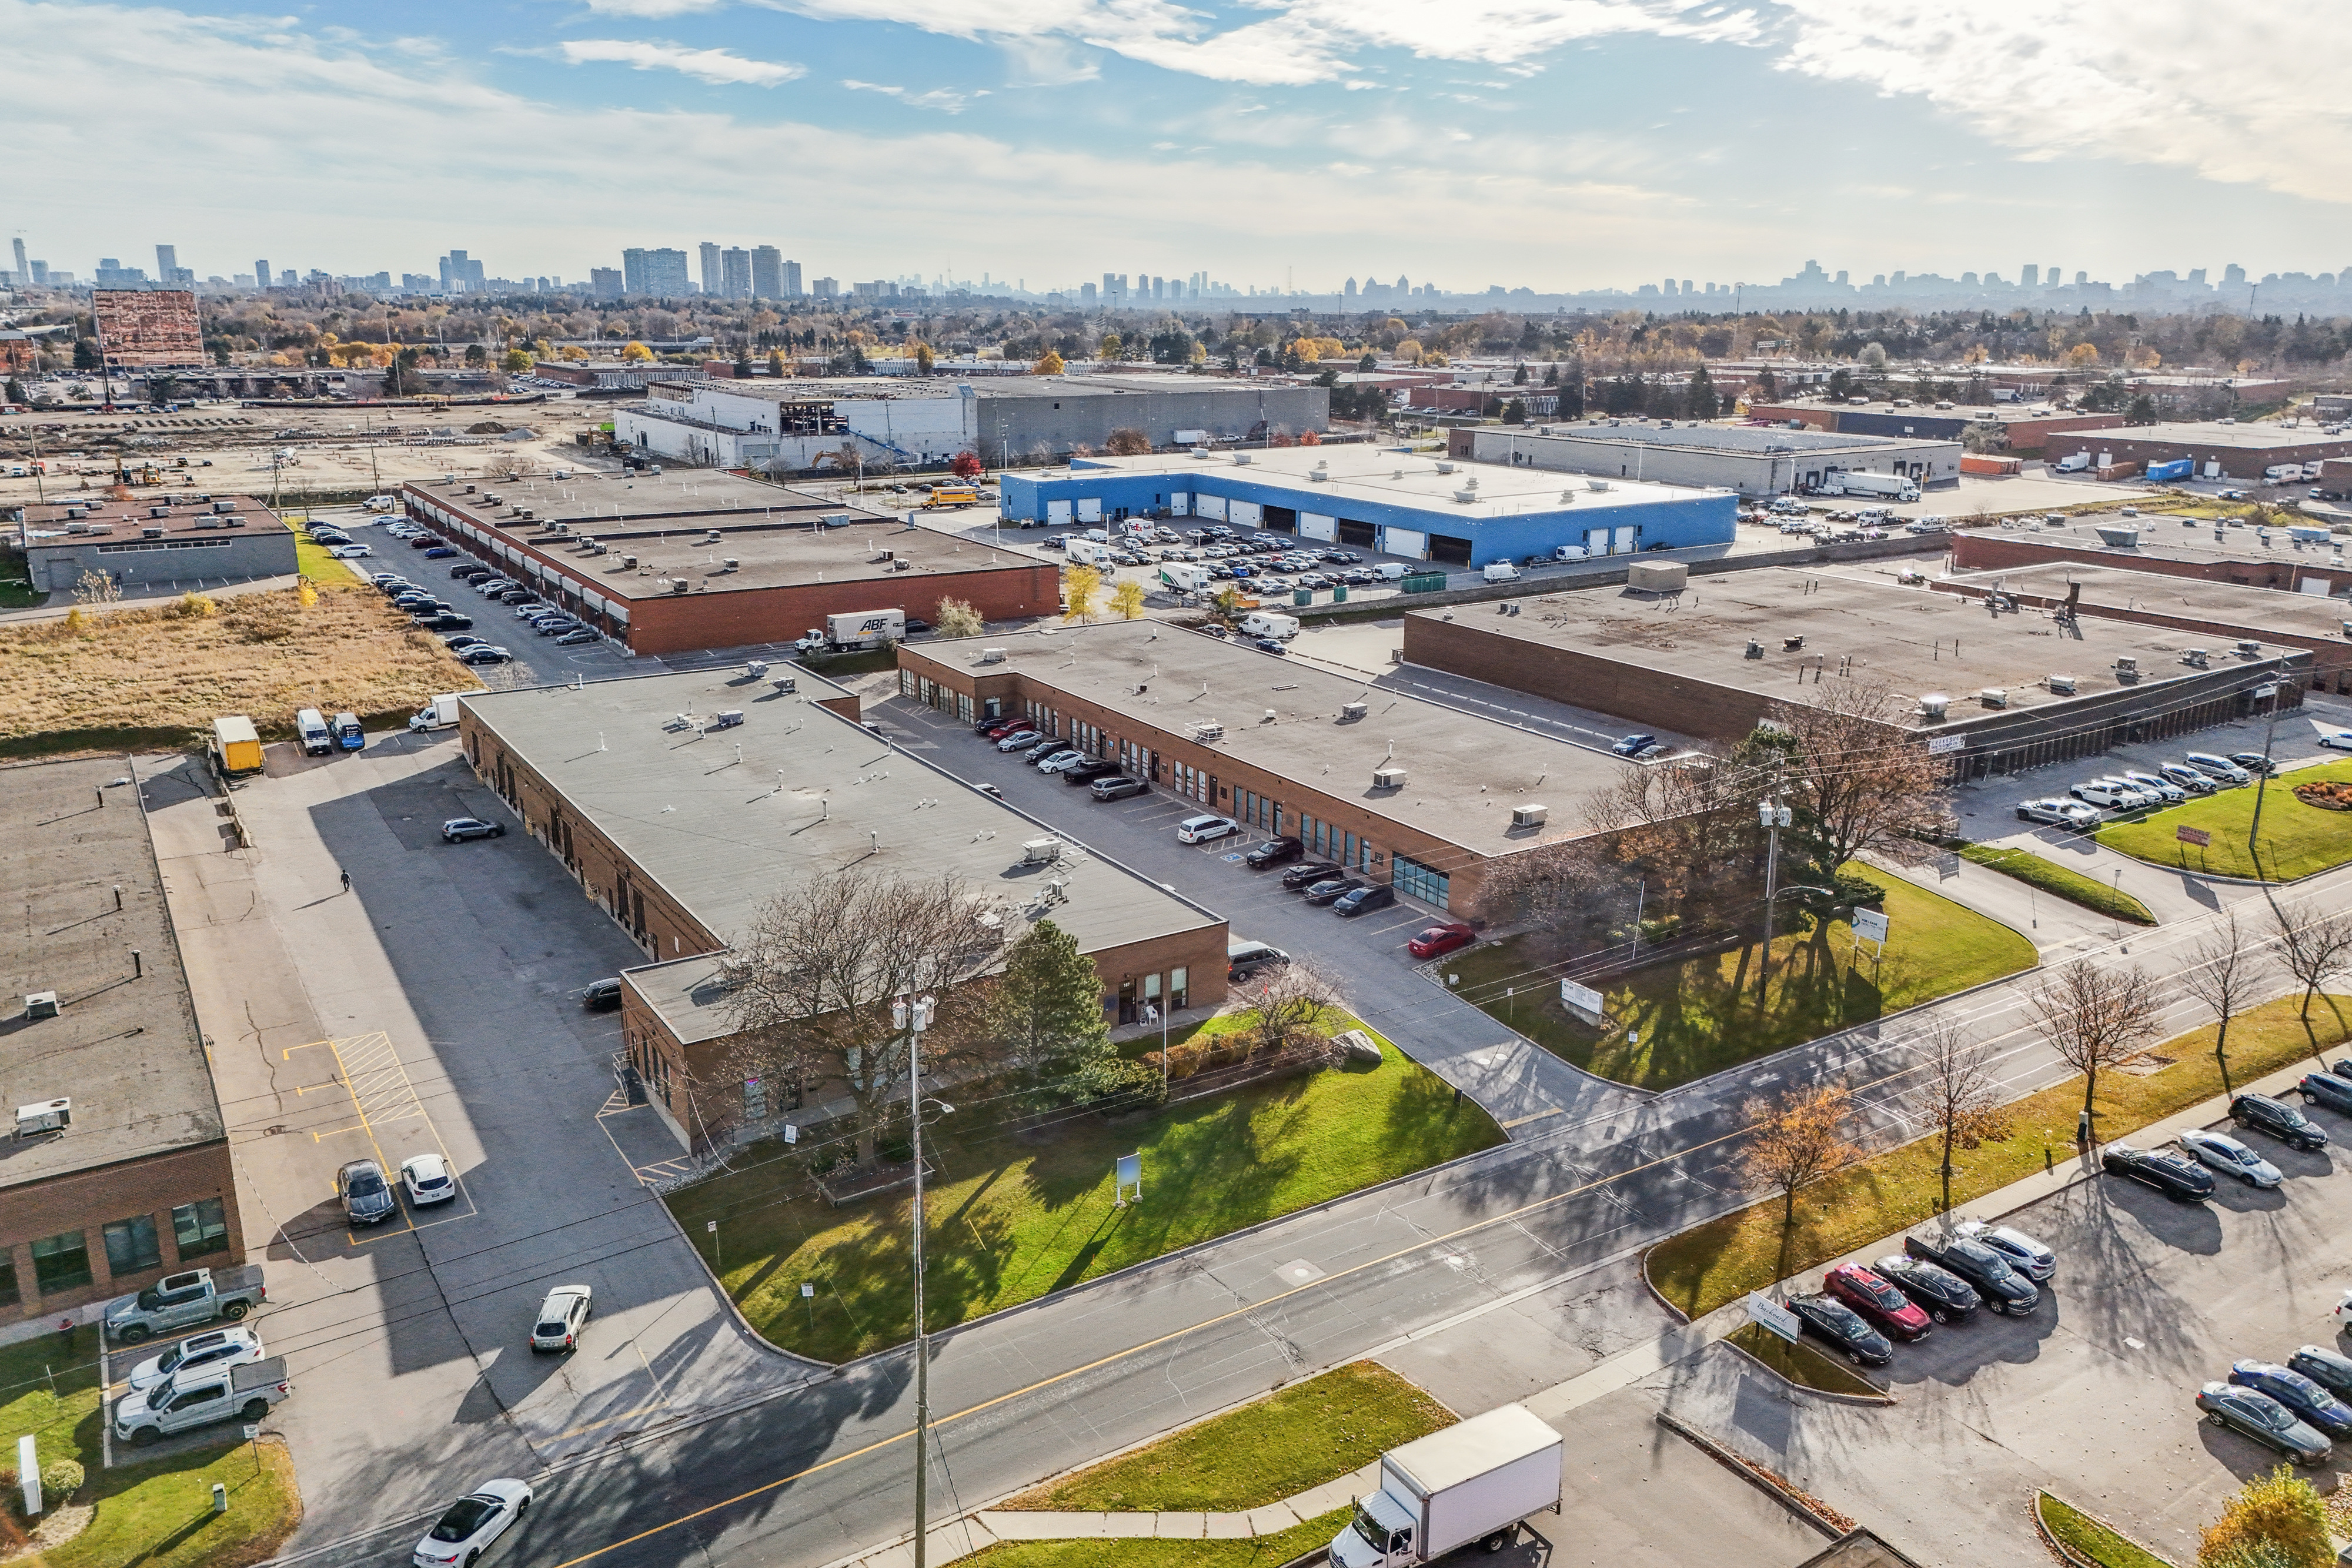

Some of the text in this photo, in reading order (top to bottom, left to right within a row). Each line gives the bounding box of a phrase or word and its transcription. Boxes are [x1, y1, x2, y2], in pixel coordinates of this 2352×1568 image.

[1877, 509, 1893, 518] FedEx
[1128, 522, 1142, 532] FedEx
[860, 618, 888, 631] ABF
[1757, 1301, 1791, 1324] Backyard
